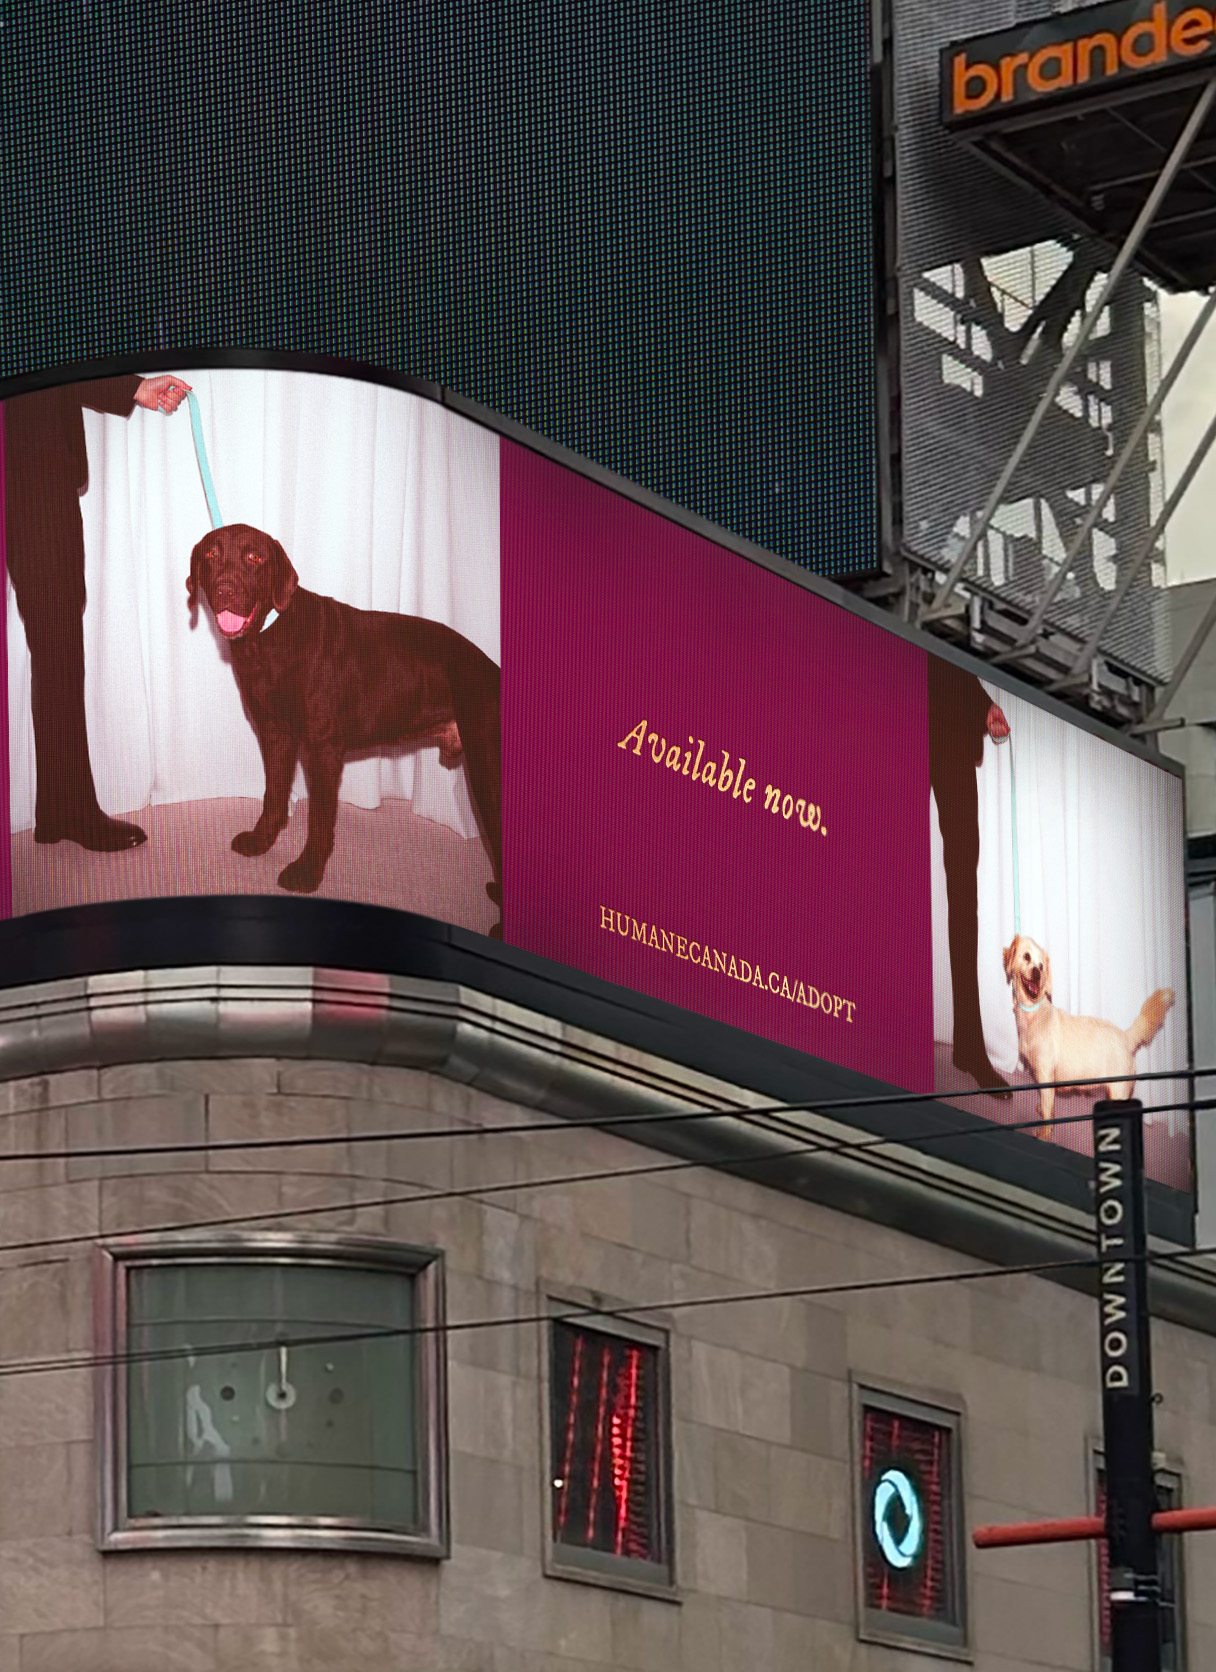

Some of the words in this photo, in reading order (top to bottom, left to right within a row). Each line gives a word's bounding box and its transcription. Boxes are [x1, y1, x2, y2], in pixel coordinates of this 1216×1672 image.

[953, 1, 1216, 114] brande
[617, 719, 756, 803] Available
[764, 784, 827, 836] now.
[600, 905, 856, 1023] HUMANECANADA.CA/ADOPT
[1098, 1127, 1128, 1388] DOWNTOWN
